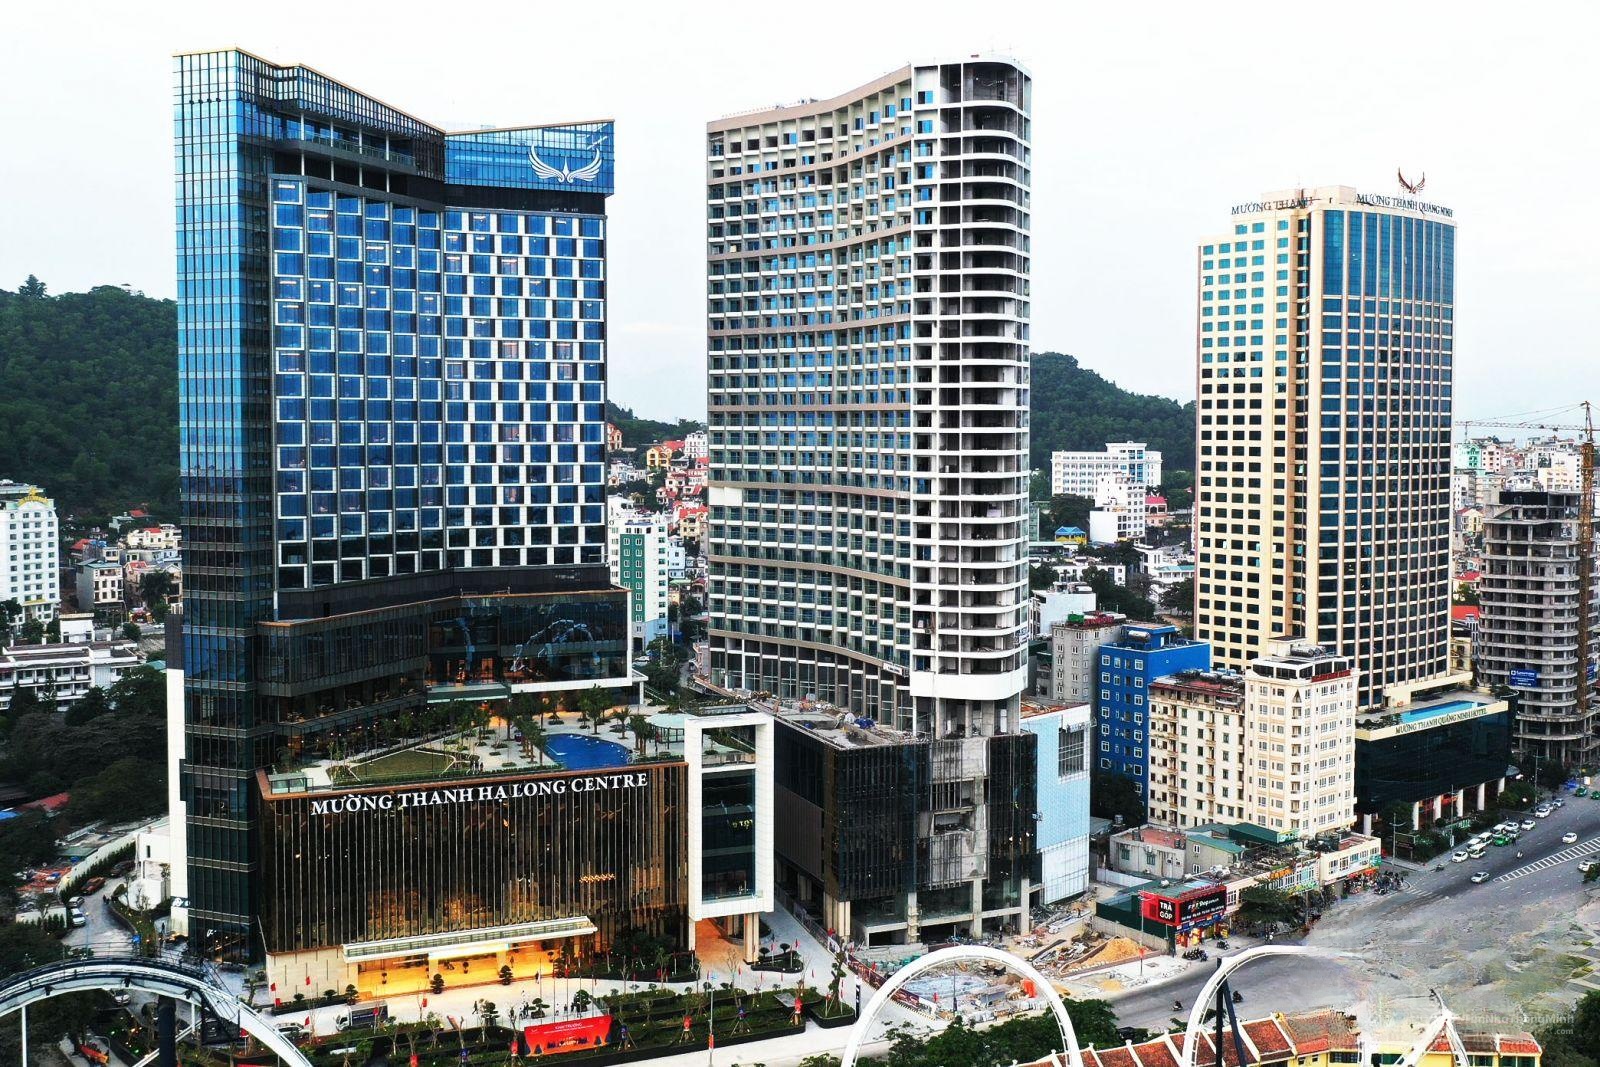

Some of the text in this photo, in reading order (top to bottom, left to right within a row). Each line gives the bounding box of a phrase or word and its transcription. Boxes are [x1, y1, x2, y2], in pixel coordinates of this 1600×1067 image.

[311, 773, 648, 815] MƯỜNG THANH HẠ LONG CENTRE
